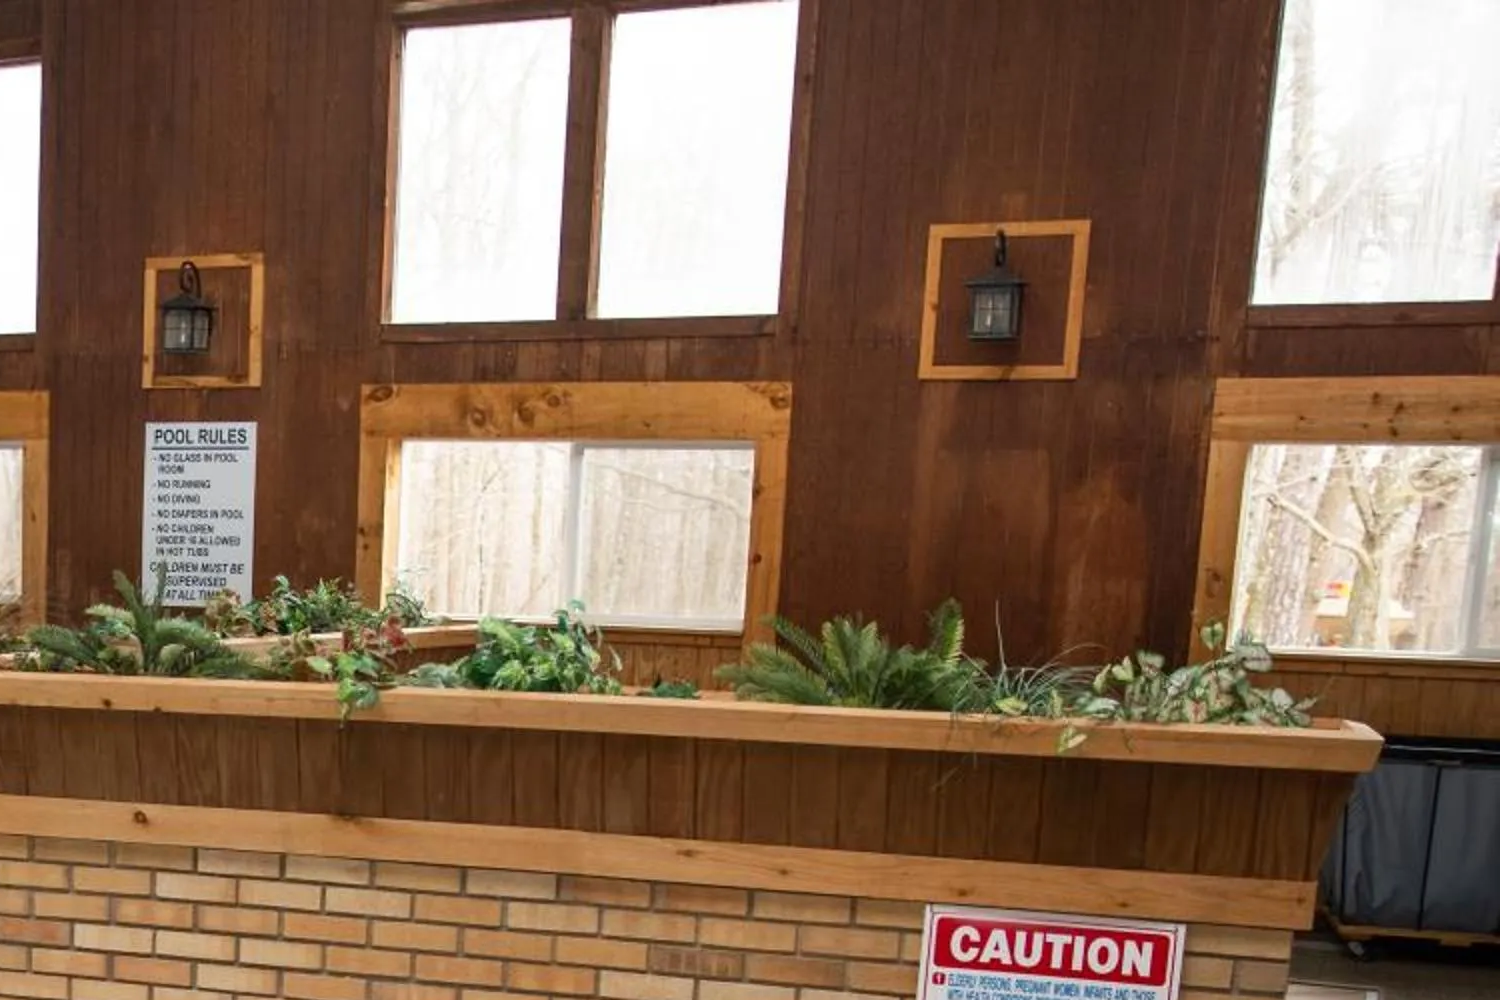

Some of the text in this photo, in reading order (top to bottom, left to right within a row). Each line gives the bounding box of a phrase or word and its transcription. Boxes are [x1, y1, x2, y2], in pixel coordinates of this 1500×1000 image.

[154, 428, 247, 445] POOL RULES
[159, 453, 239, 463] NO GLASS IN POOL
[158, 480, 211, 489] NO RUNNING
[158, 494, 170, 504] NO
[158, 509, 244, 519] NO DIAPERS IN POOL
[157, 523, 214, 534] NO CHILDREN
[198, 536, 241, 546] ALLOWED
[156, 548, 164, 557] IN
[201, 562, 228, 574] MUST
[229, 563, 245, 574] BE
[178, 589, 197, 601] ALL
[950, 926, 1153, 977] CAUTION
[1113, 987, 1129, 1000] AND
